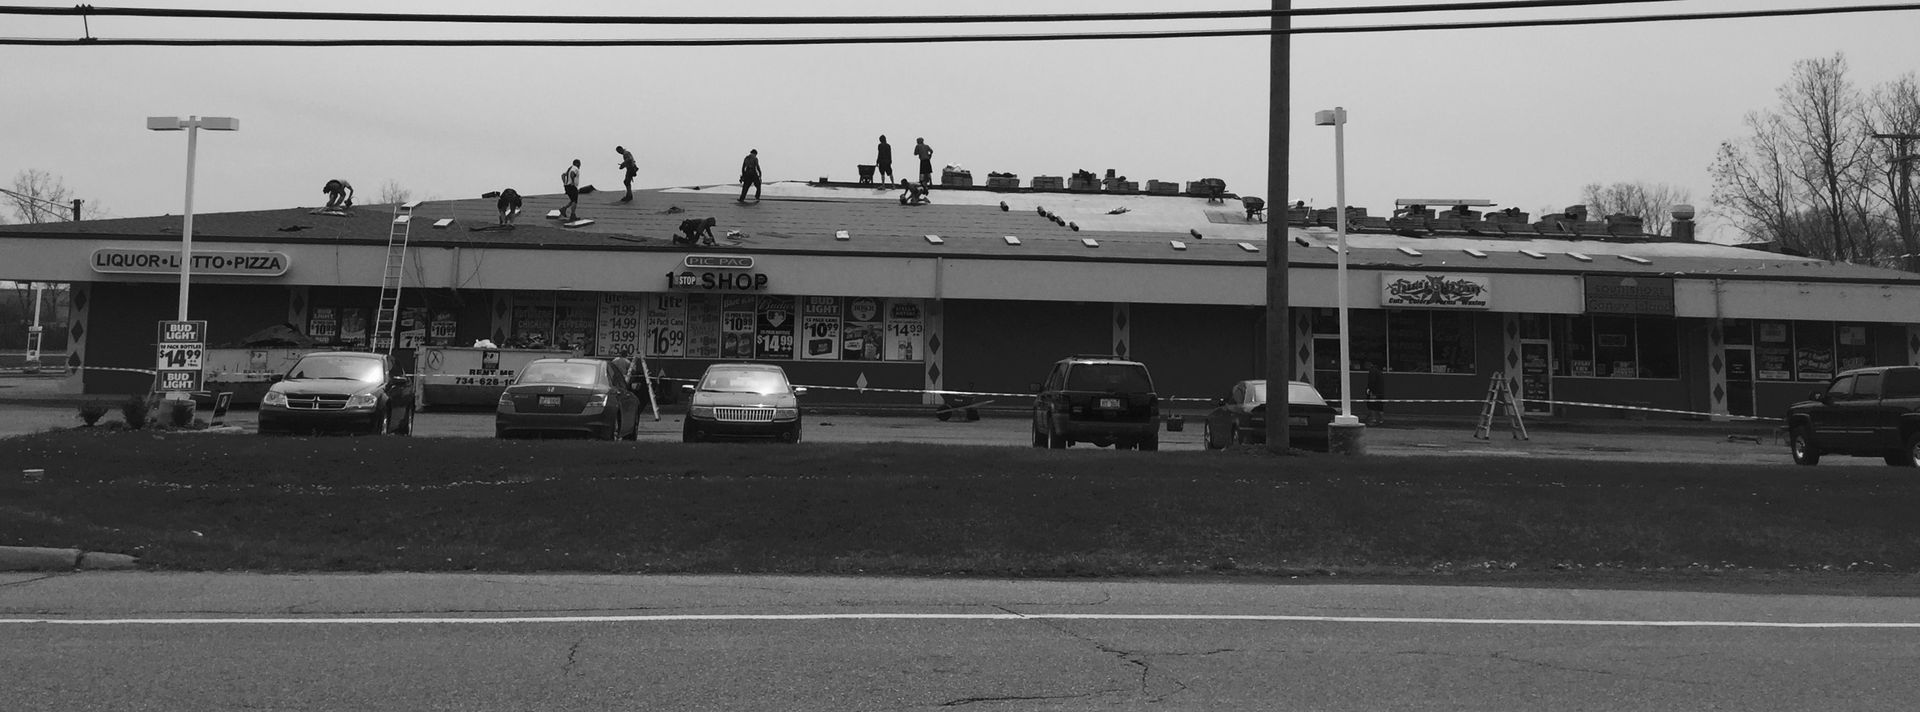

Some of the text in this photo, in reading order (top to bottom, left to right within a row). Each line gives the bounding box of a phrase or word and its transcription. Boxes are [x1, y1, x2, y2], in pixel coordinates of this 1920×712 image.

[96, 253, 281, 269] LIQUOR LTTO PIZZA
[689, 257, 752, 266] PIC PAC
[666, 272, 768, 290] 1 STOP SHOP
[659, 295, 683, 310] Lite
[811, 297, 835, 305] BUD
[806, 305, 839, 313] LIGHT
[170, 324, 192, 332] BUD
[166, 332, 196, 340] LIGHT
[167, 373, 190, 381] BUD
[163, 381, 194, 389] LIGHT
